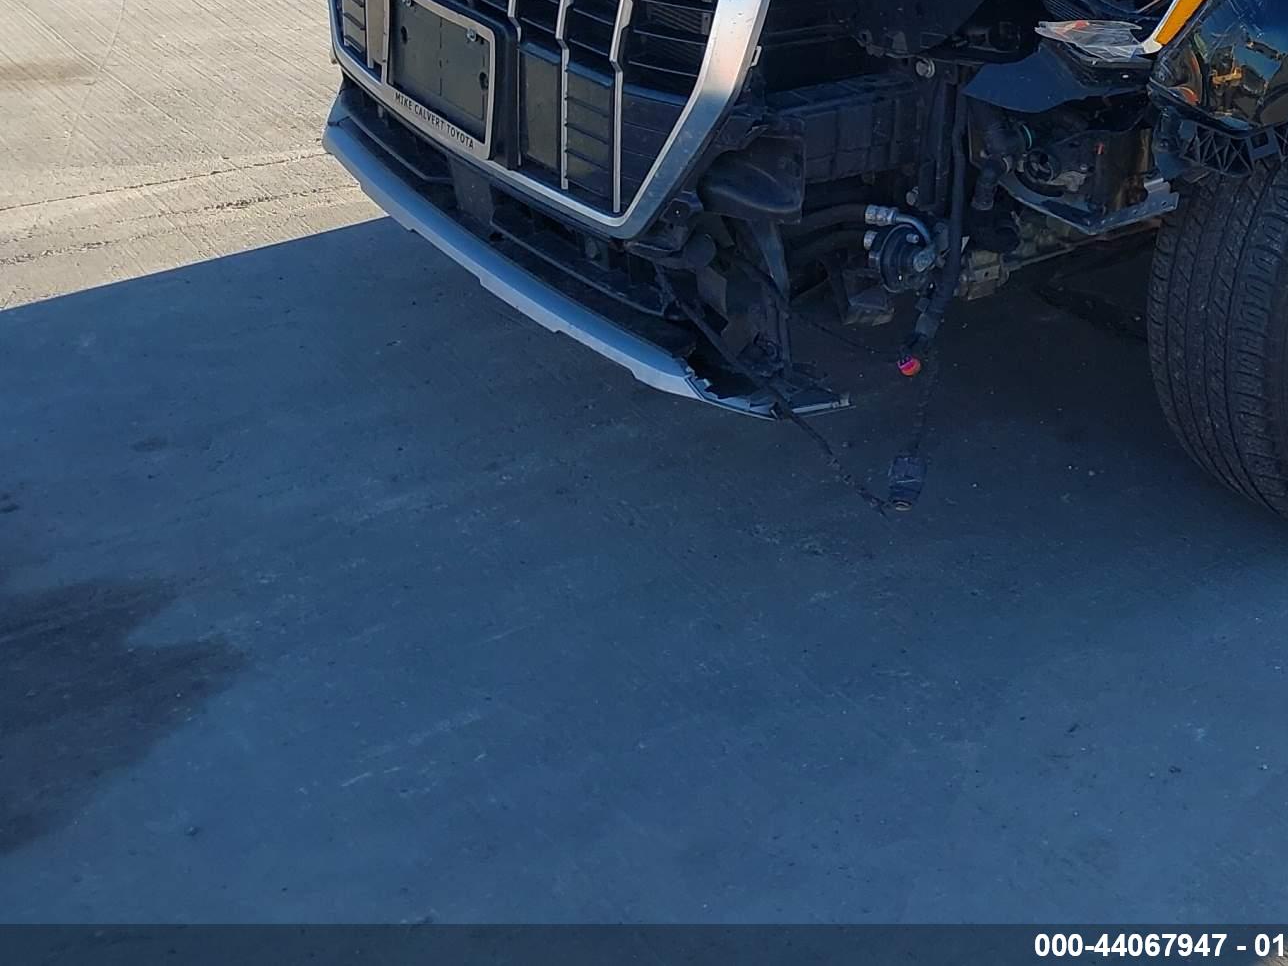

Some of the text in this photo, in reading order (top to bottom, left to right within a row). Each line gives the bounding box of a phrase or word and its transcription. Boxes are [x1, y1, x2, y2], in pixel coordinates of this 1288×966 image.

[395, 92, 474, 149] MIKE CALVERT TOYOTA
